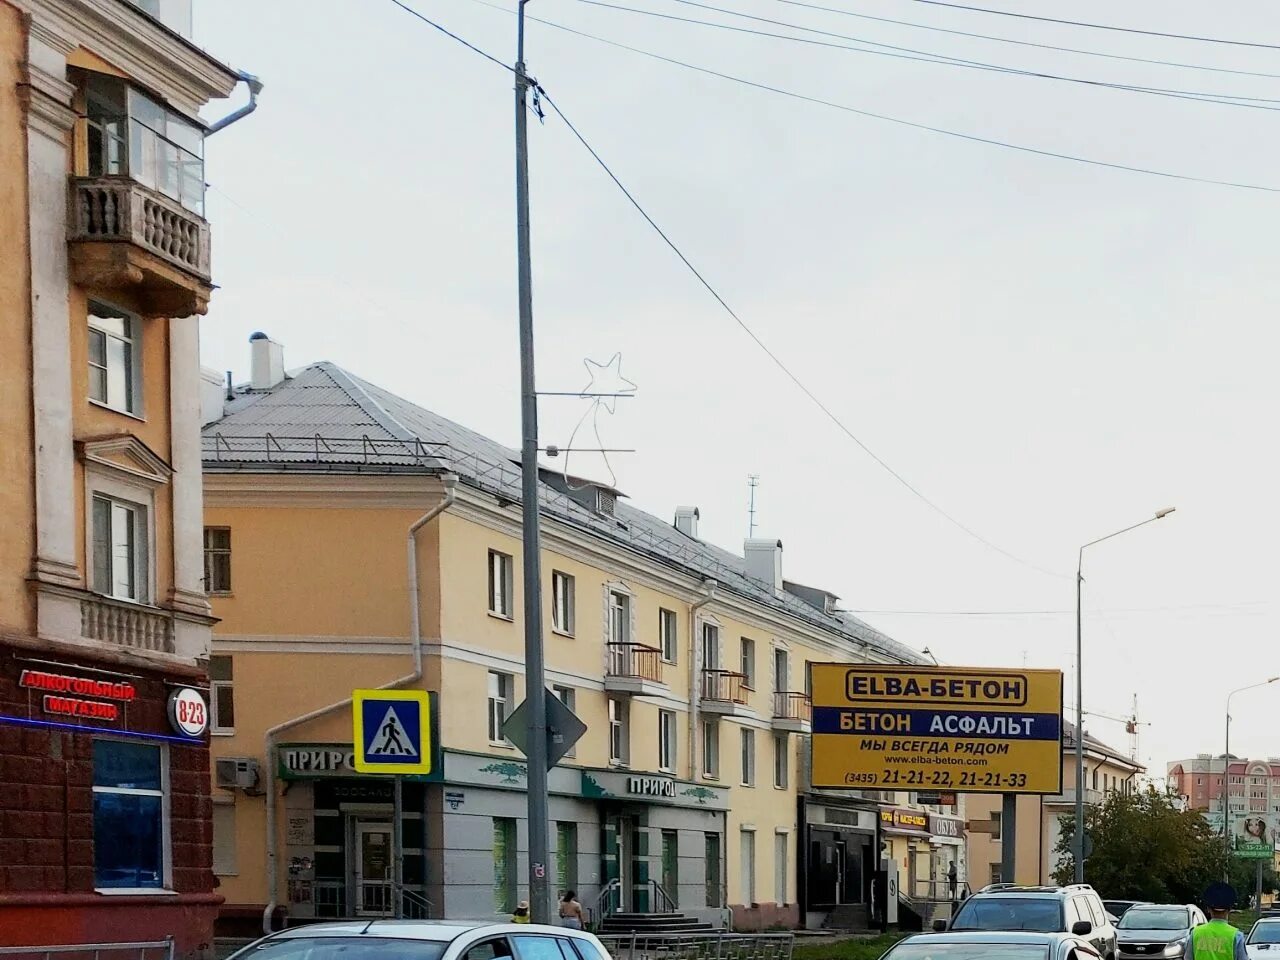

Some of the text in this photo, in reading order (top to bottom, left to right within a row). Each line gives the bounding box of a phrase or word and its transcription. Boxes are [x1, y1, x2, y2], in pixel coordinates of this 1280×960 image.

[852, 676, 1021, 700] ELBA-БЕТОН
[47, 696, 118, 719] МАГАЗИН
[839, 712, 1035, 735] БЕТОН АСФАЛЬТ
[860, 739, 1010, 755] МЫ ВСЕГДА РЯДОМ
[286, 750, 355, 771] ПРИРО
[884, 755, 988, 766] www.elba-beton.com
[844, 772, 878, 785] (3435)
[959, 771, 1027, 787] 21-21-33
[936, 819, 958, 836] ОБУВЬ
